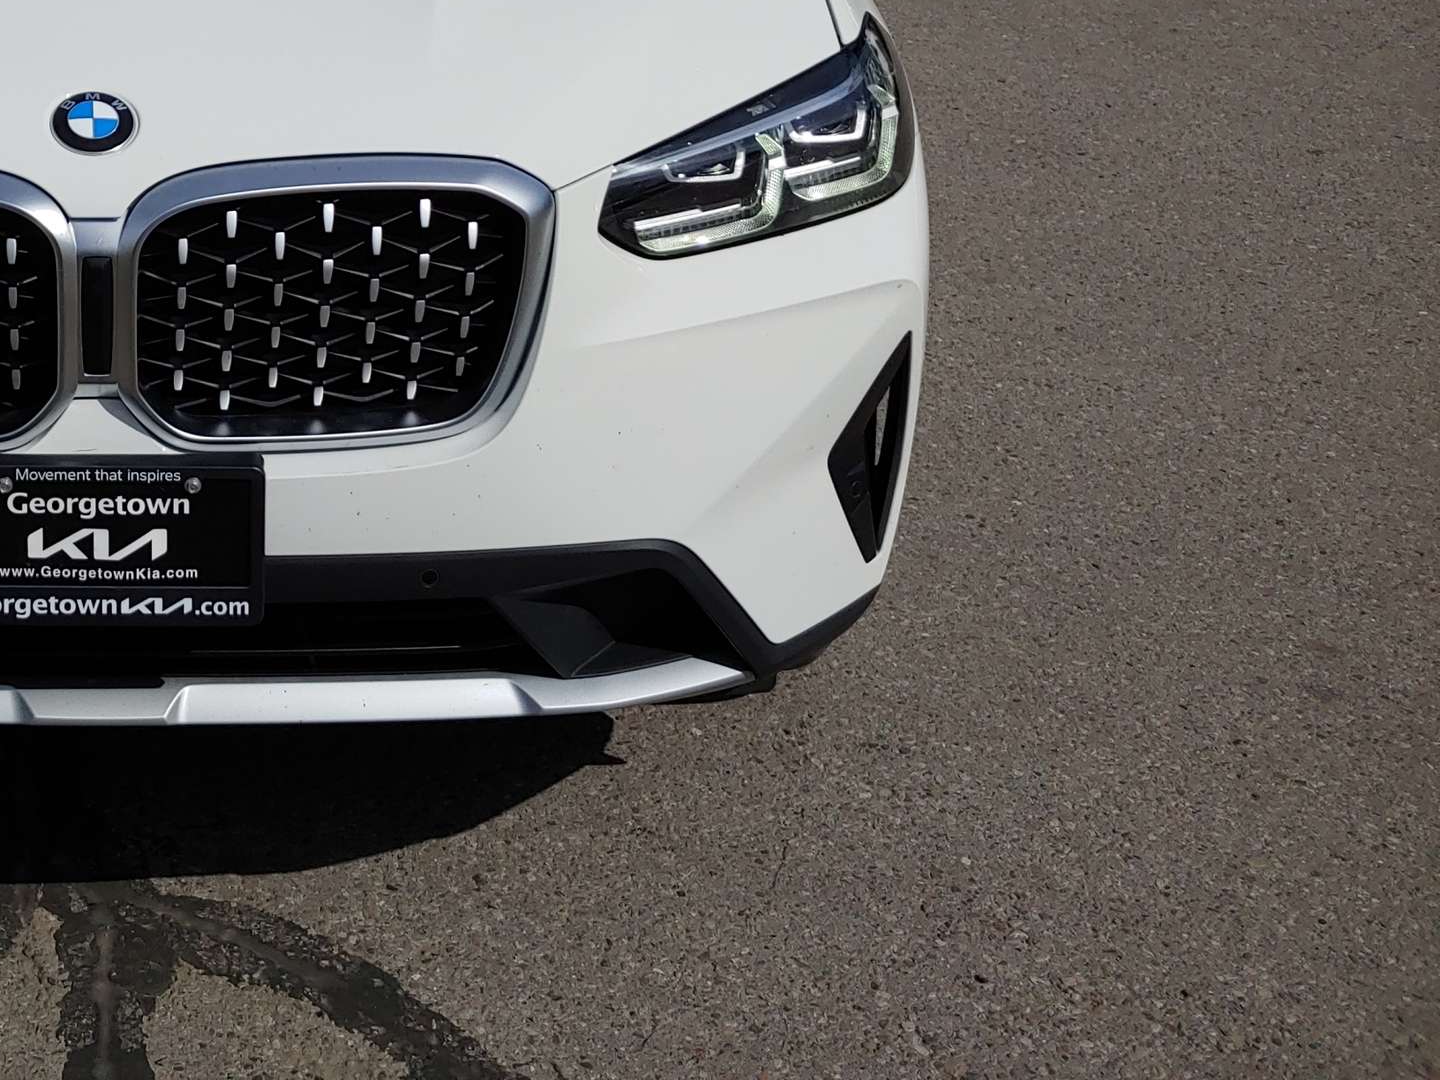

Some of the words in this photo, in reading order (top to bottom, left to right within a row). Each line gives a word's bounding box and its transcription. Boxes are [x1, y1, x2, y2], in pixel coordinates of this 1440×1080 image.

[60, 93, 128, 112] BMW
[15, 467, 91, 482] Movement
[94, 468, 123, 482] that
[127, 468, 181, 484] inspires
[6, 492, 191, 520] Georgetown
[27, 527, 168, 561] KIA
